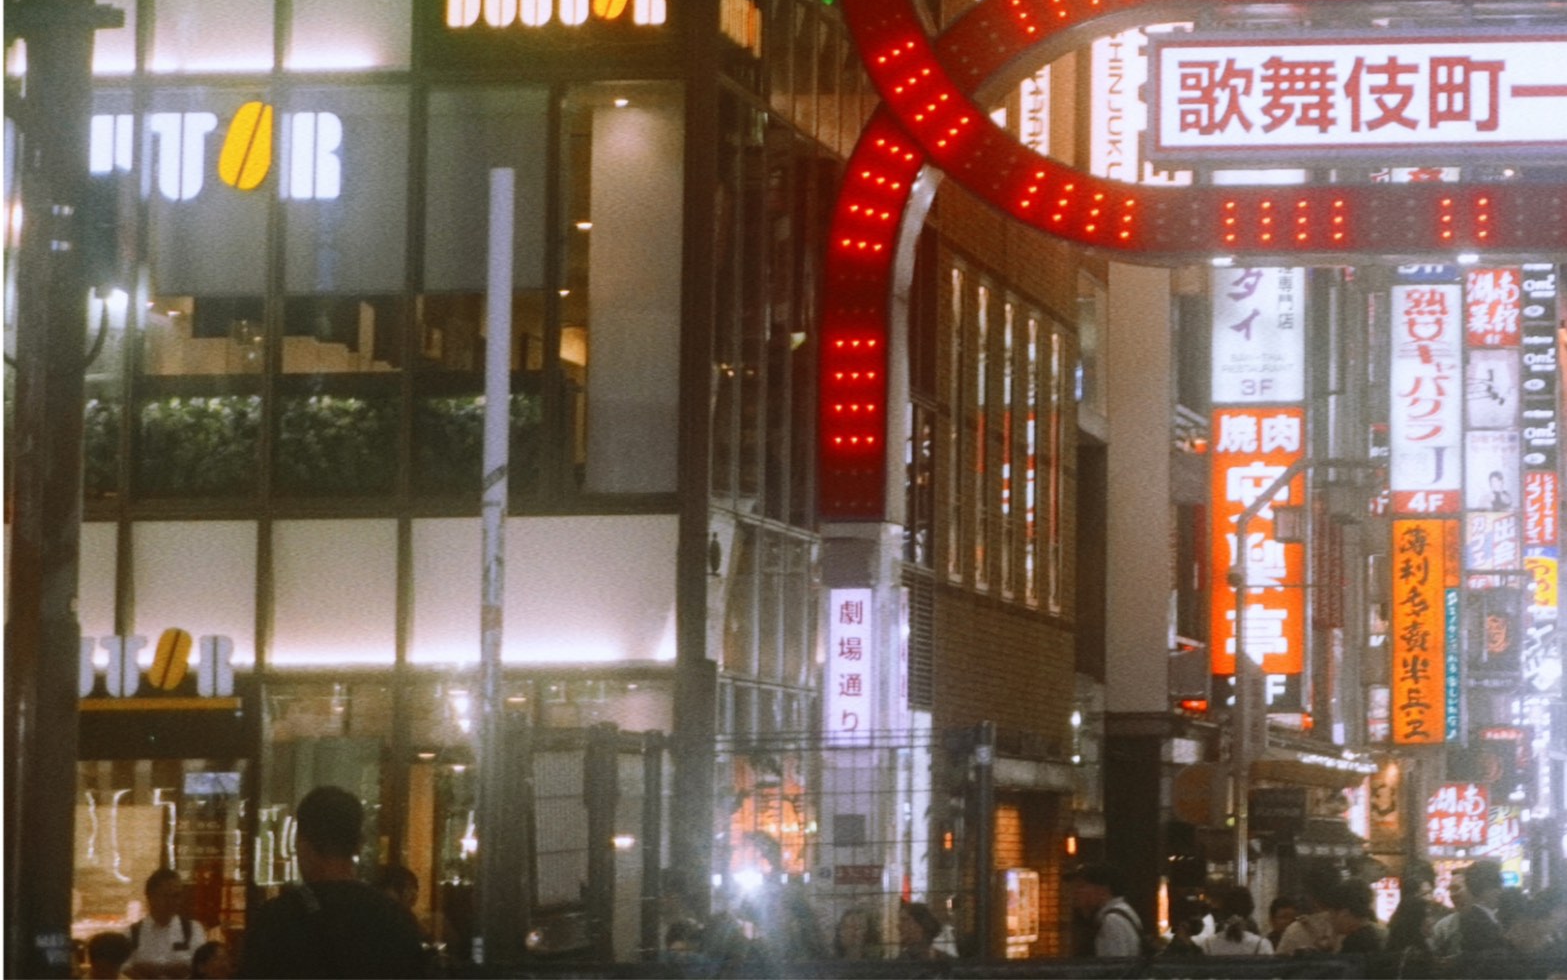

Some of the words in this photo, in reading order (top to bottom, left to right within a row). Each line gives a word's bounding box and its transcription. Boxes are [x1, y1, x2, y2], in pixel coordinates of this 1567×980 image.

[1241, 379, 1273, 396] 3F
[1217, 414, 1301, 454] 焼肉
[1407, 492, 1445, 513] 4F
[837, 599, 863, 733] 劇場通り
